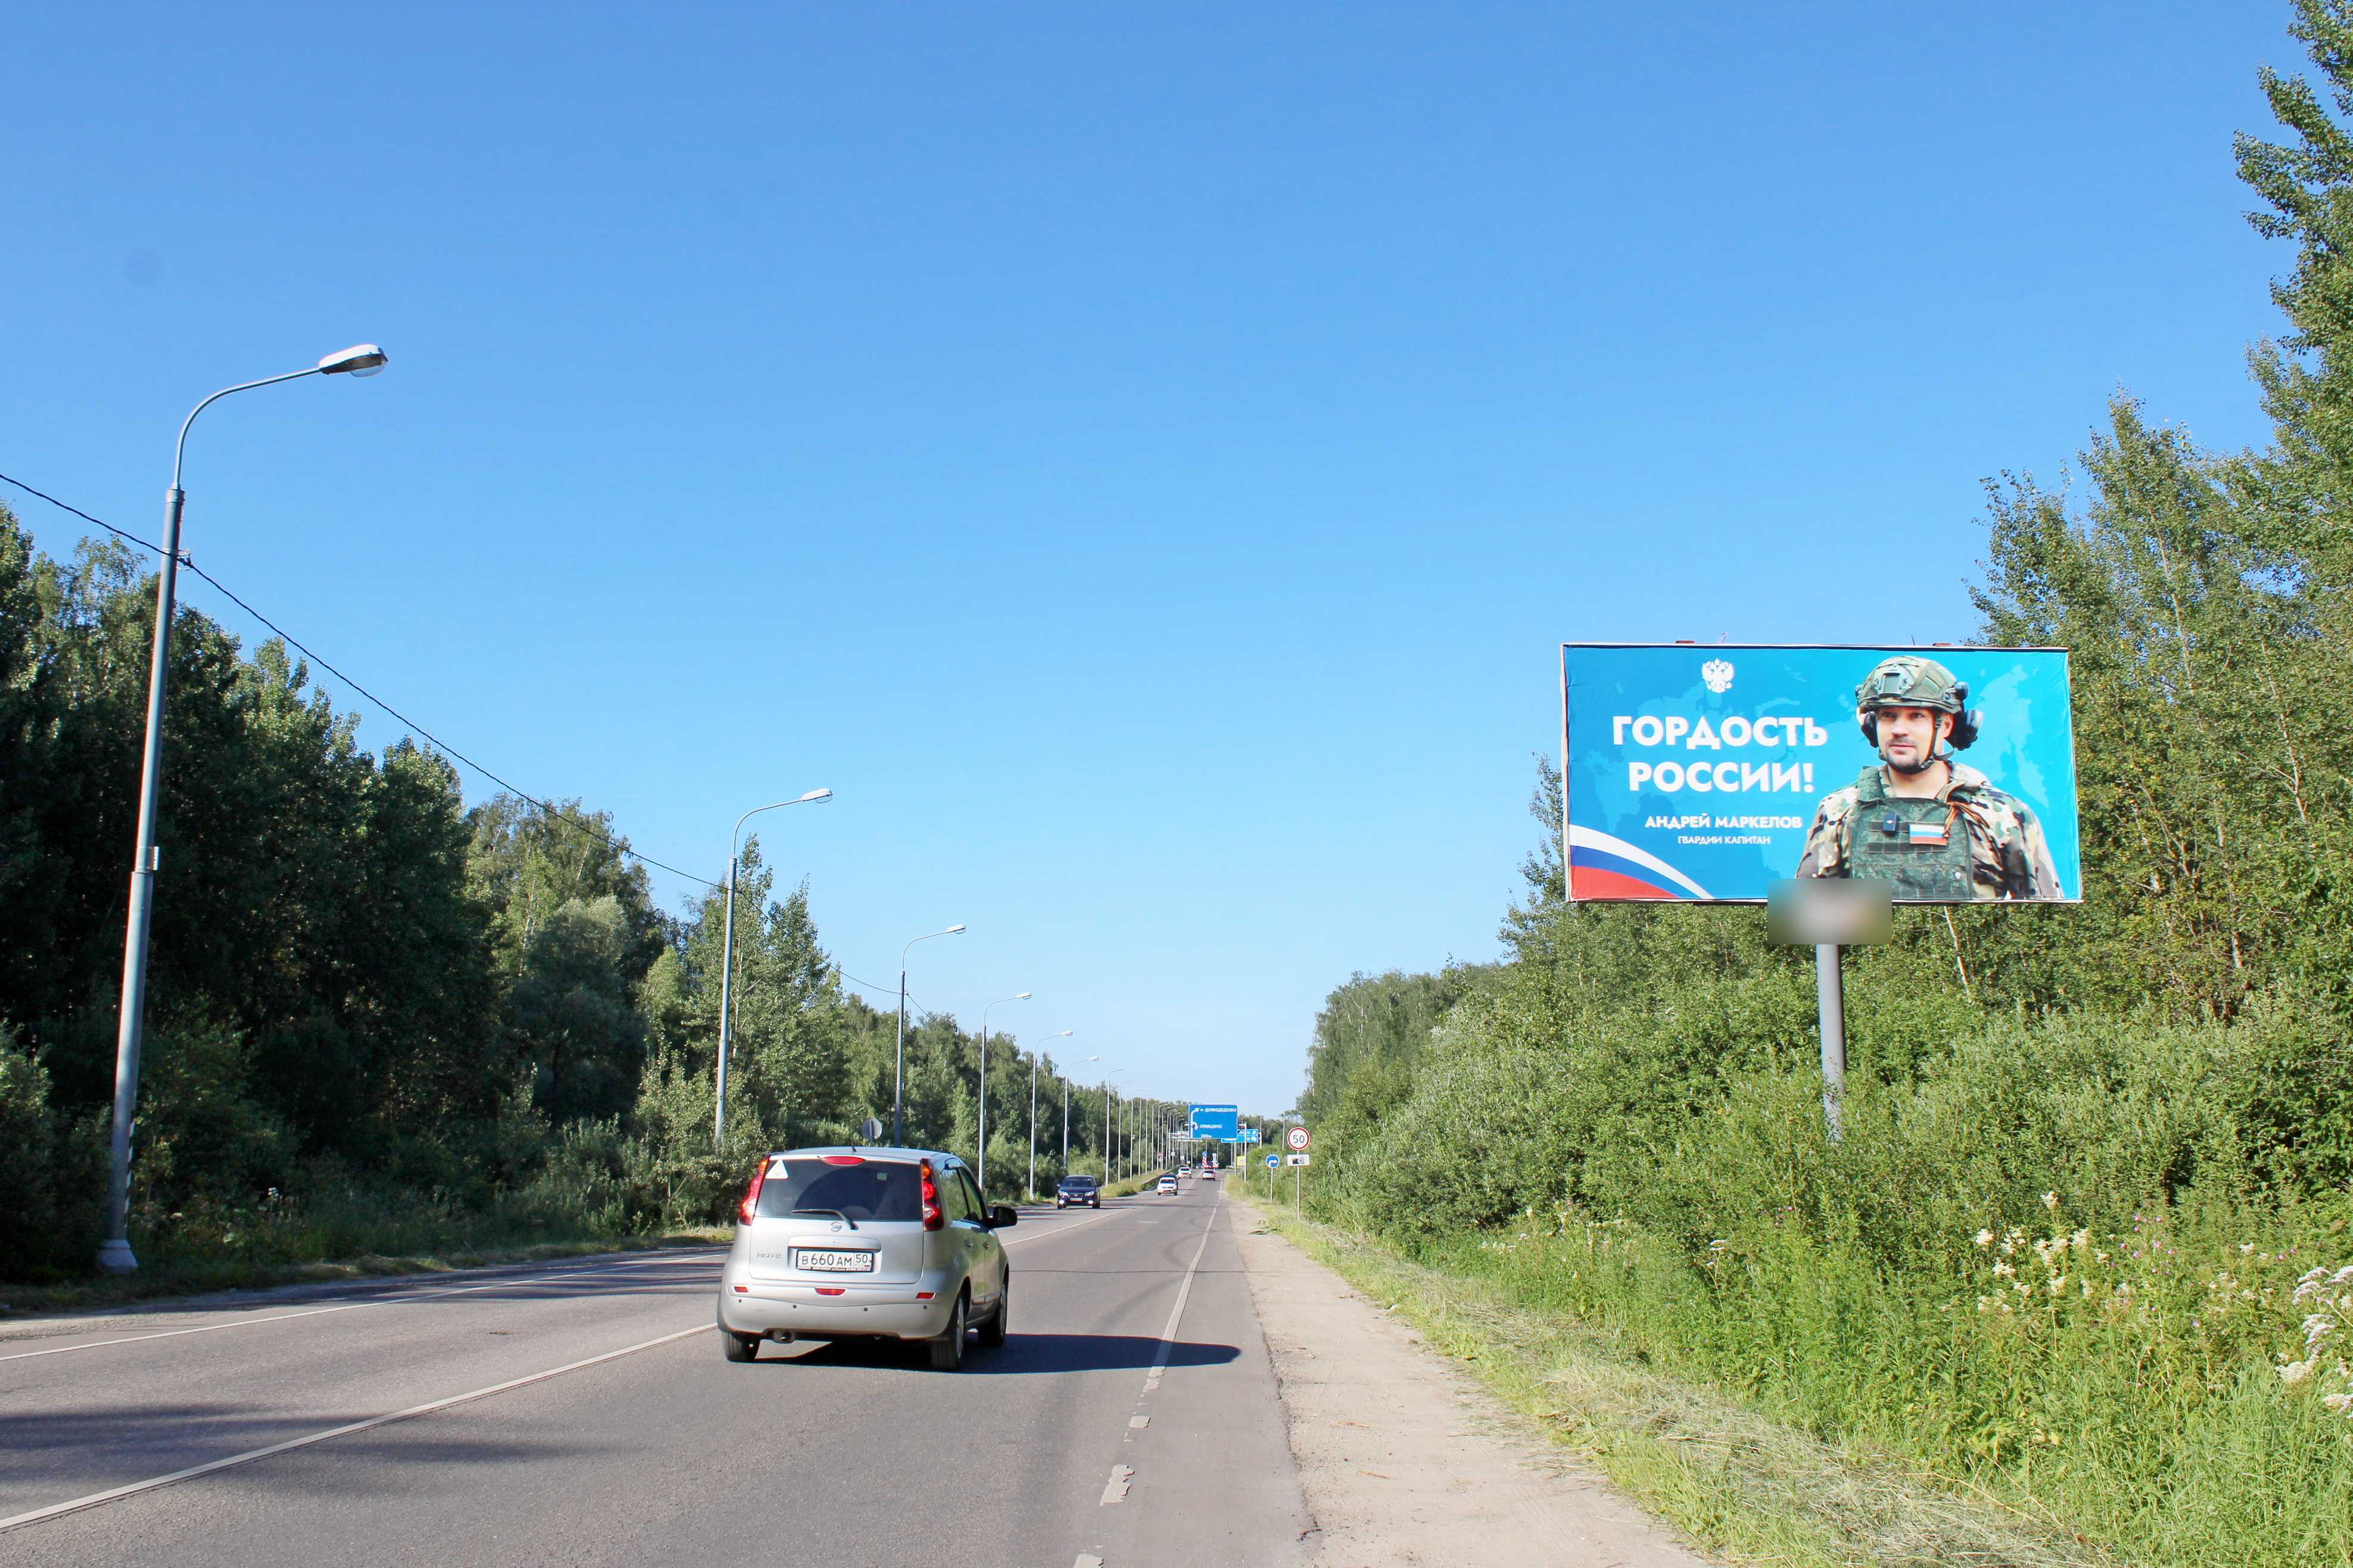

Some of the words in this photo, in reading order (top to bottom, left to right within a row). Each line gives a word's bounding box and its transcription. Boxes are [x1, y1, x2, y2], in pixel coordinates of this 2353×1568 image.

[1613, 715, 1828, 750] ГОРДОСТЬ
[1629, 762, 1814, 793] РОССИИ!
[1644, 813, 1710, 829] АНДРЕЙ
[1714, 816, 1803, 828] МАРКЕЛОВ
[1677, 836, 1722, 844] ГВАРДИИ
[1725, 836, 1771, 844] КАПИТАН
[1293, 1135, 1305, 1143] 50
[856, 1254, 868, 1263] 50
